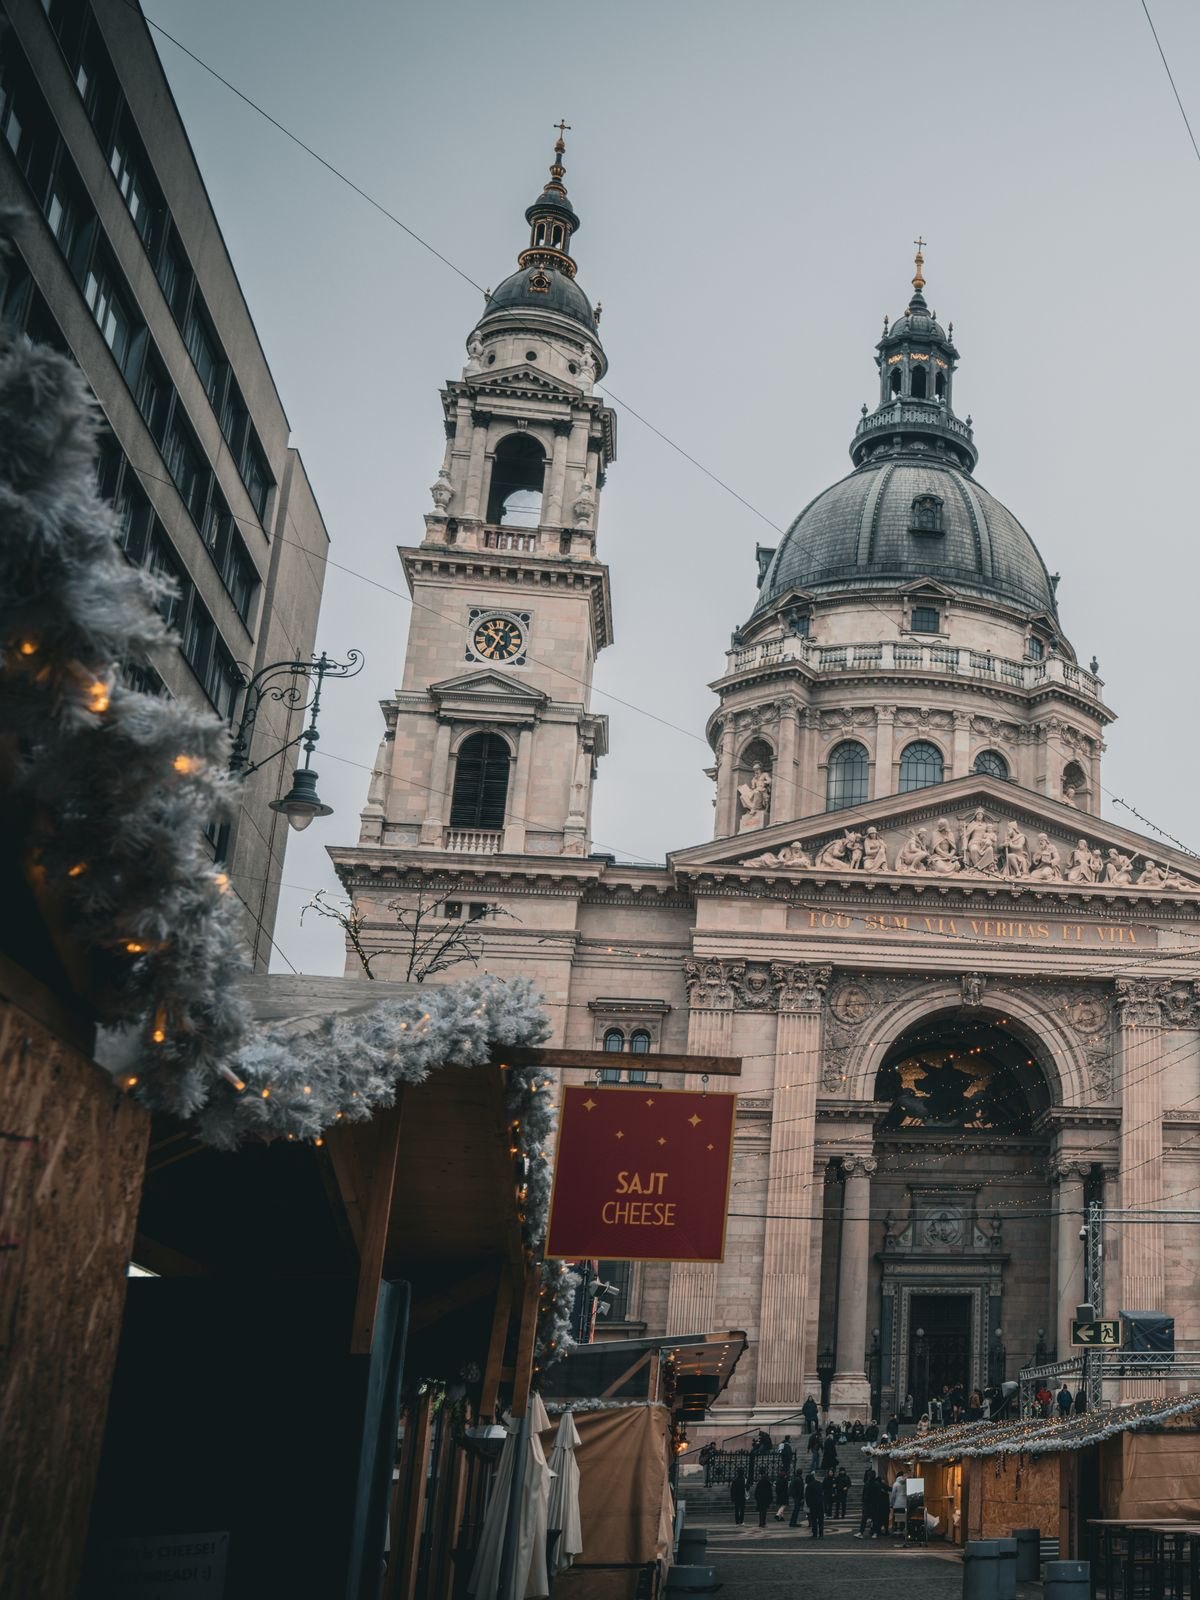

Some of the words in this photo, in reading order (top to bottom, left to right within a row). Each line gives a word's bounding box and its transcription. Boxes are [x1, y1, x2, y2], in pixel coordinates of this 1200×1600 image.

[864, 914, 909, 933] SUM
[924, 917, 959, 935] VIA
[970, 920, 1050, 940] VERITAS
[1061, 925, 1086, 941] ET
[1095, 926, 1137, 944] VITA
[615, 1171, 669, 1196] SAJT
[601, 1201, 677, 1226] CHEESE
